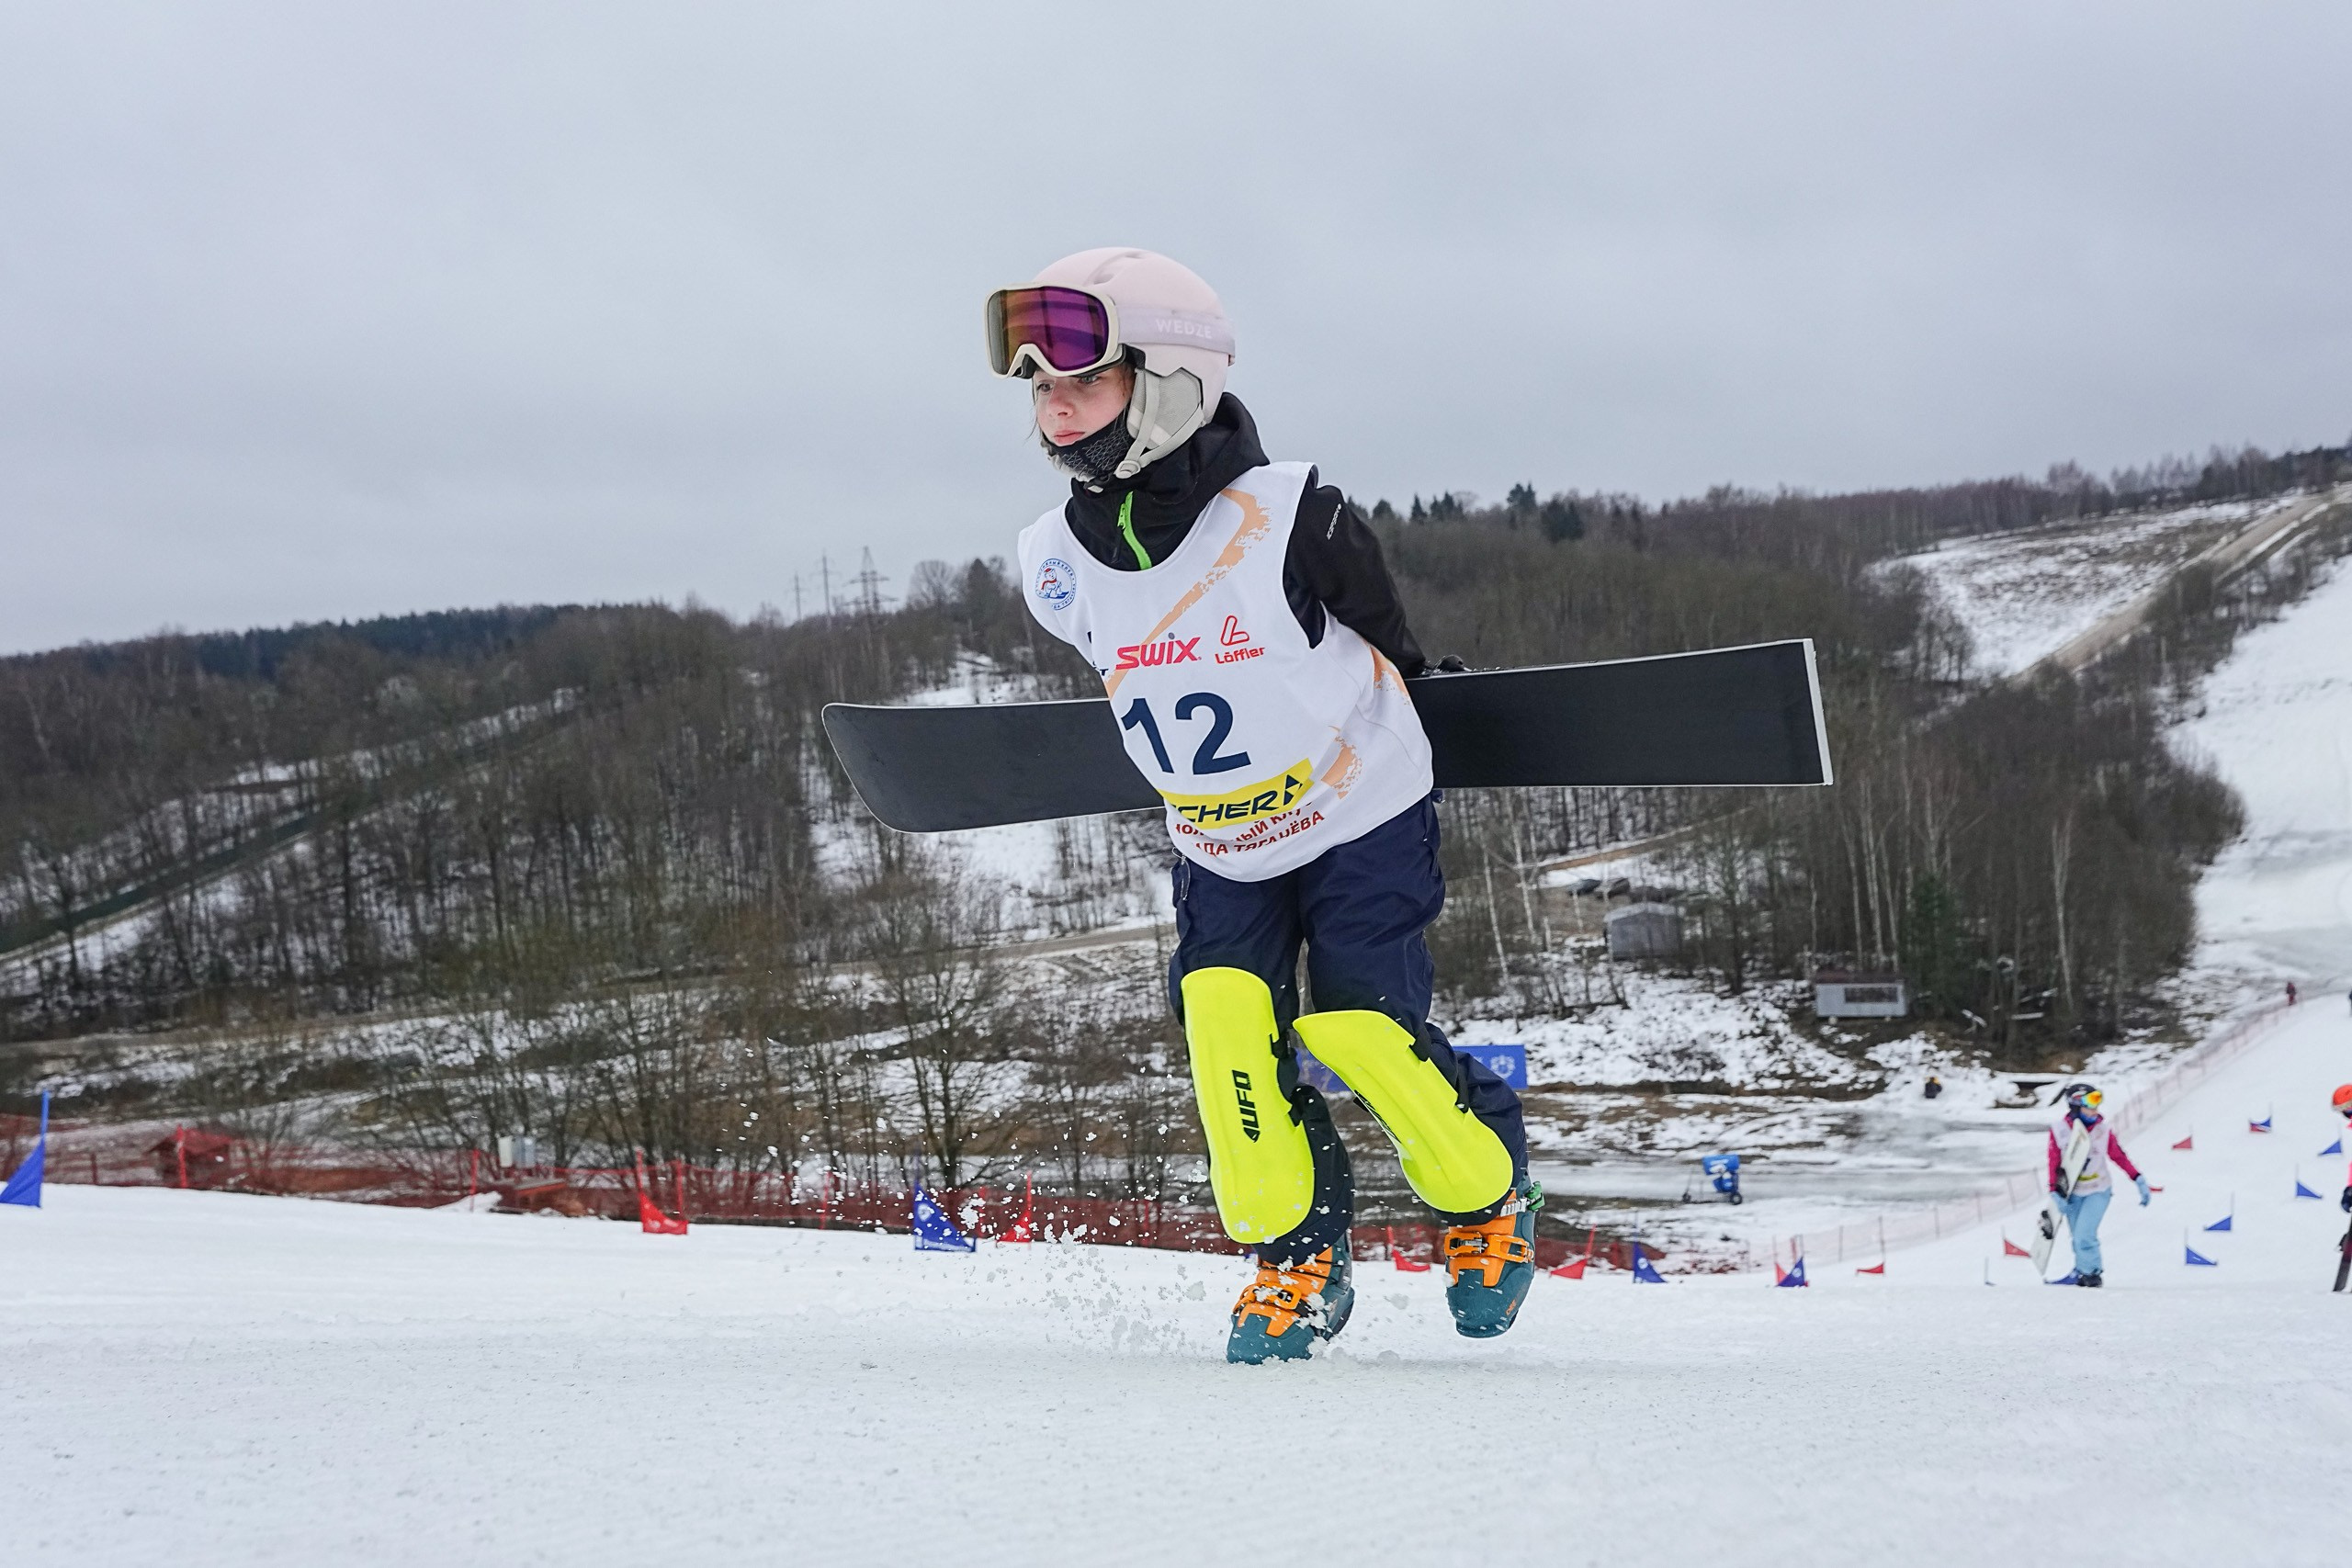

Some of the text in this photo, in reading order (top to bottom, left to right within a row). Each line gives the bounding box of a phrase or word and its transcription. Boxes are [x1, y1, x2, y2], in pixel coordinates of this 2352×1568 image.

[1156, 319, 1213, 340] WEDZE
[1215, 647, 1266, 664] Löffler
[1121, 692, 1251, 775] 12
[1171, 790, 1280, 823] CHER
[1232, 1069, 1260, 1129] UFO
